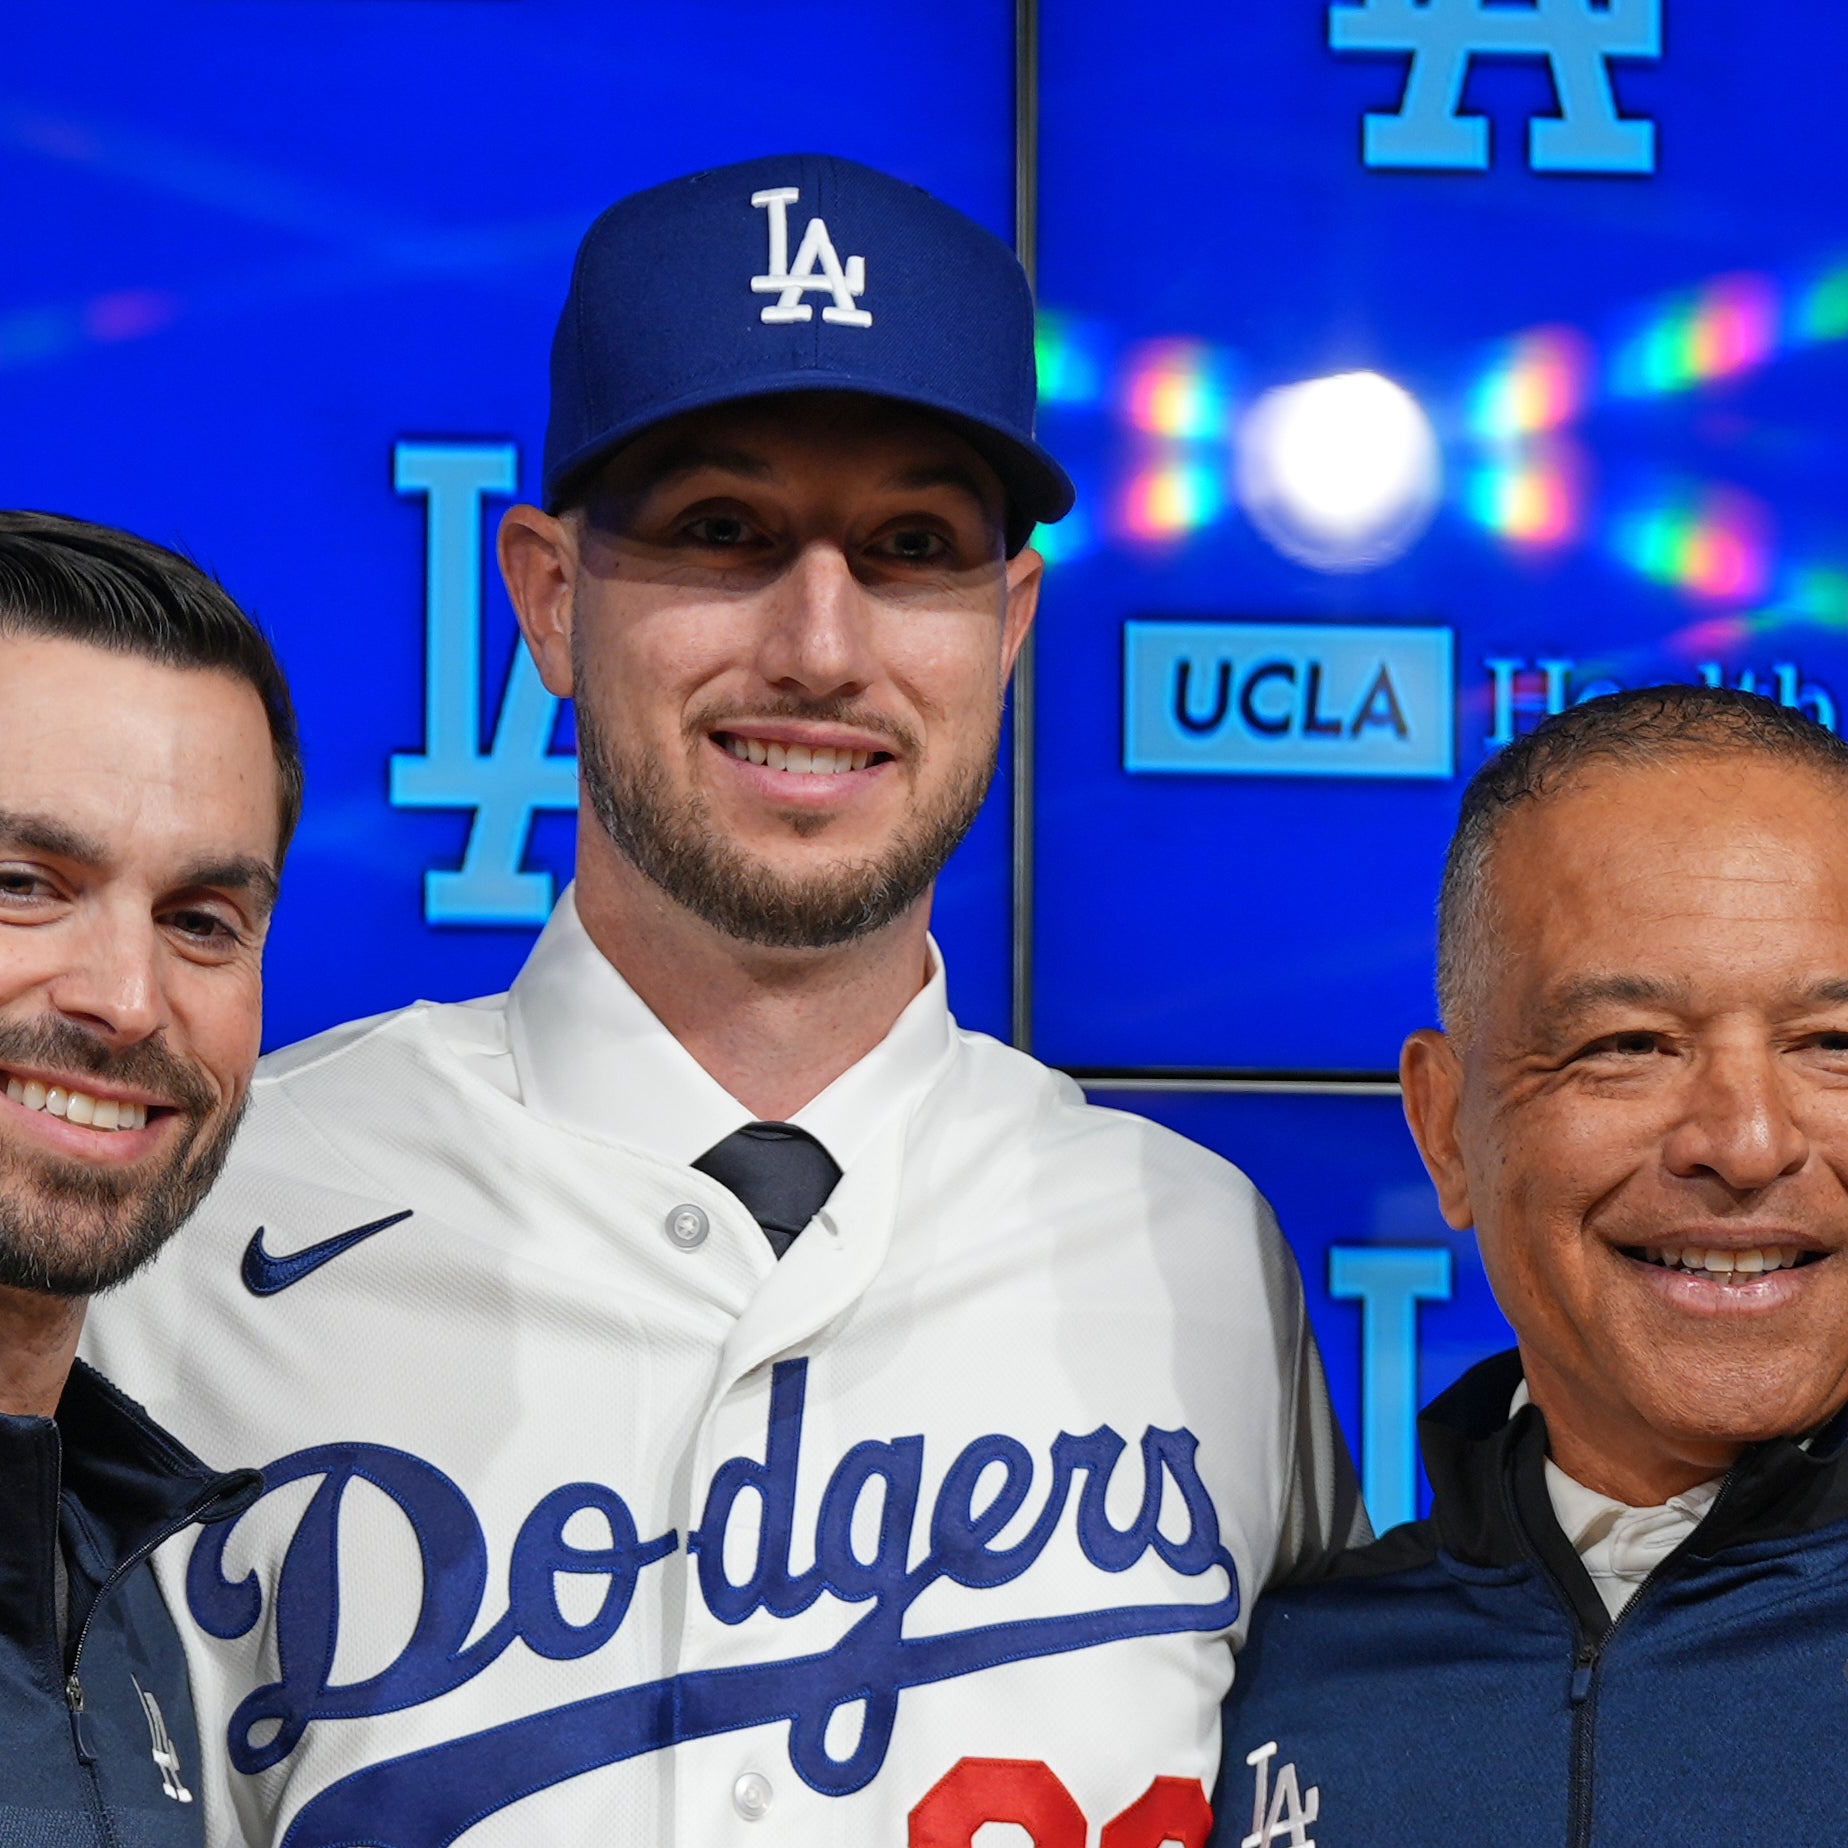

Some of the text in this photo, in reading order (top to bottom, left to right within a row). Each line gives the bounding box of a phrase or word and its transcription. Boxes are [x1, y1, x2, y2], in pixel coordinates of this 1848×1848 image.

[750, 186, 872, 327] LA
[1173, 659, 1411, 741] UCLA
[186, 1357, 1240, 1797] Dodgers
